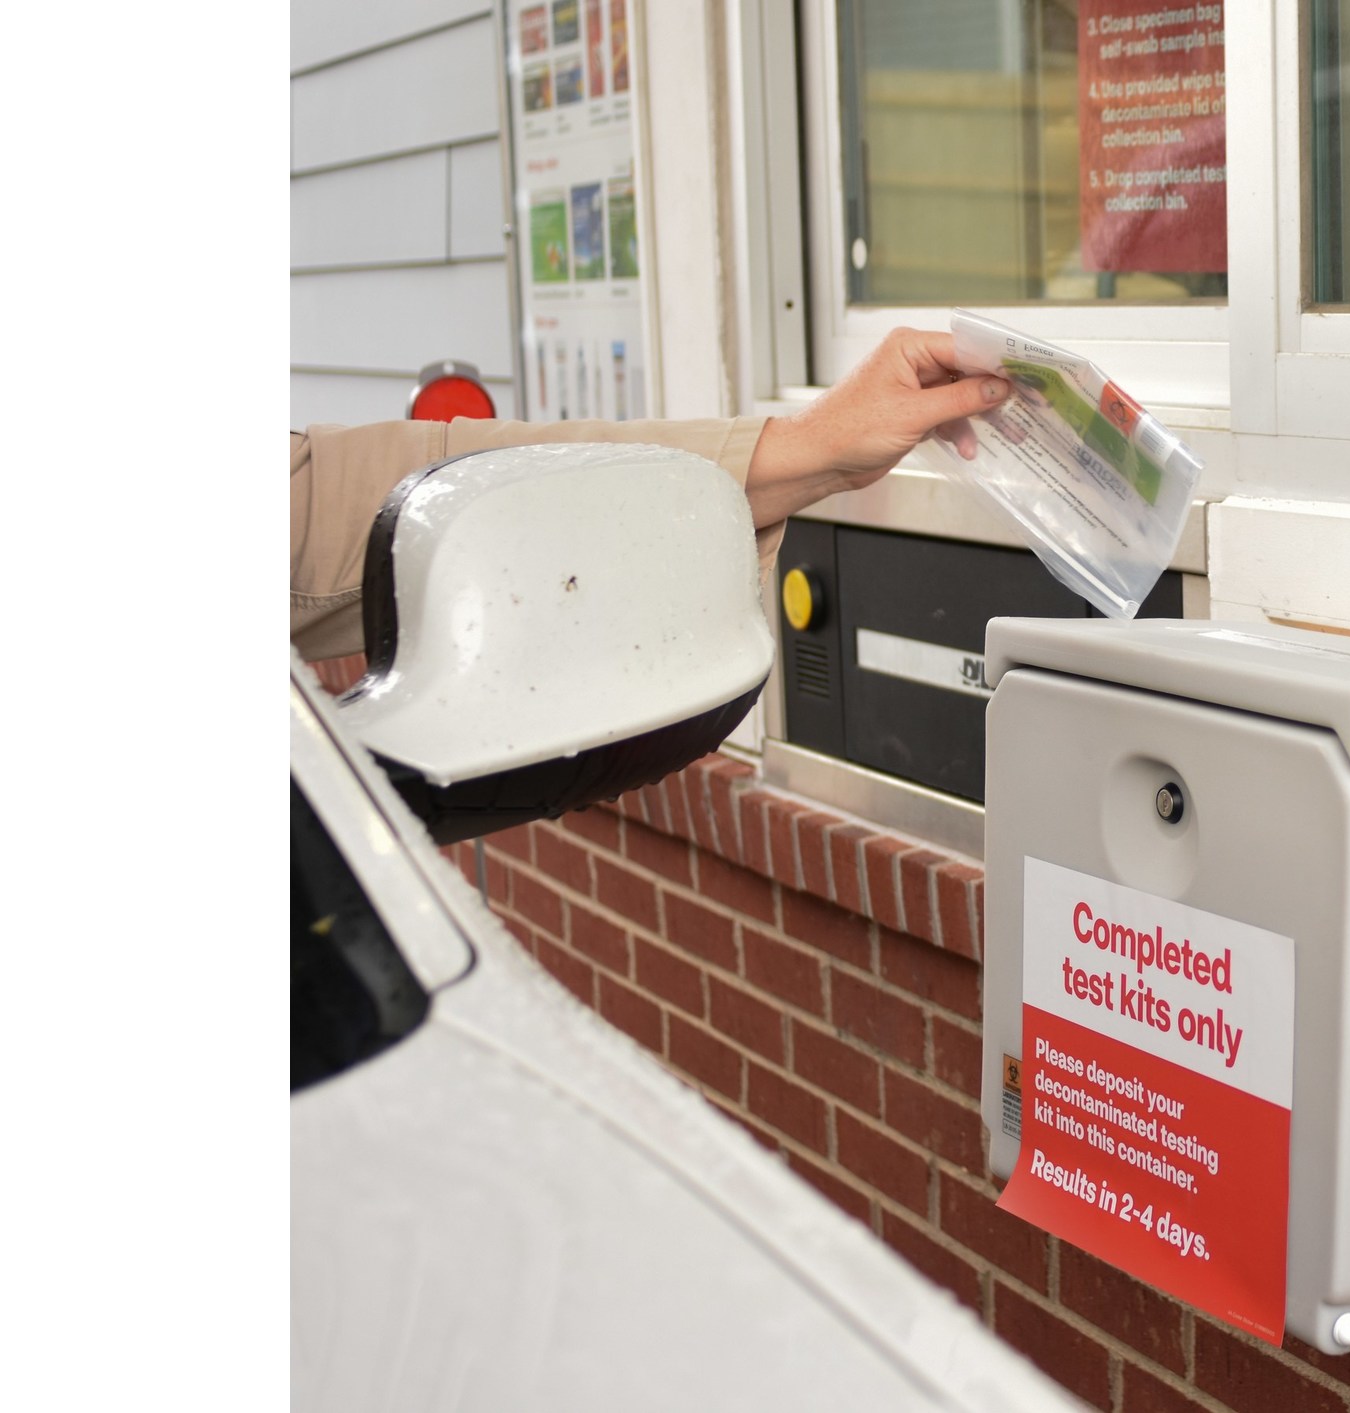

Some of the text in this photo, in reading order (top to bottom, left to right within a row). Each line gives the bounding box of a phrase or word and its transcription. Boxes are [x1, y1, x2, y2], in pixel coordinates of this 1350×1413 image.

[1088, 1, 1221, 36] 3. Close specimen bag
[1100, 37, 1158, 59] self-swab
[1160, 31, 1205, 55] sample
[1088, 70, 1226, 102] 4. Use provided wipe to
[1101, 95, 1225, 123] decontaminate lid of
[1102, 126, 1185, 148] collection bin.
[1090, 164, 1226, 190] 5. Drop completed test
[1105, 193, 1188, 212] collection bin.
[1072, 901, 1233, 995] Completed
[1062, 957, 1243, 1069] test kits only
[1035, 1037, 1184, 1121] Please deposit your
[1035, 1073, 1158, 1143] decontaminated
[1160, 1123, 1219, 1176] testing
[1034, 1097, 1054, 1125] kit
[1056, 1106, 1085, 1140] into
[1087, 1121, 1115, 1155] this
[1118, 1139, 1199, 1195] container.
[1030, 1147, 1211, 1262] Results in 2-4 days.
